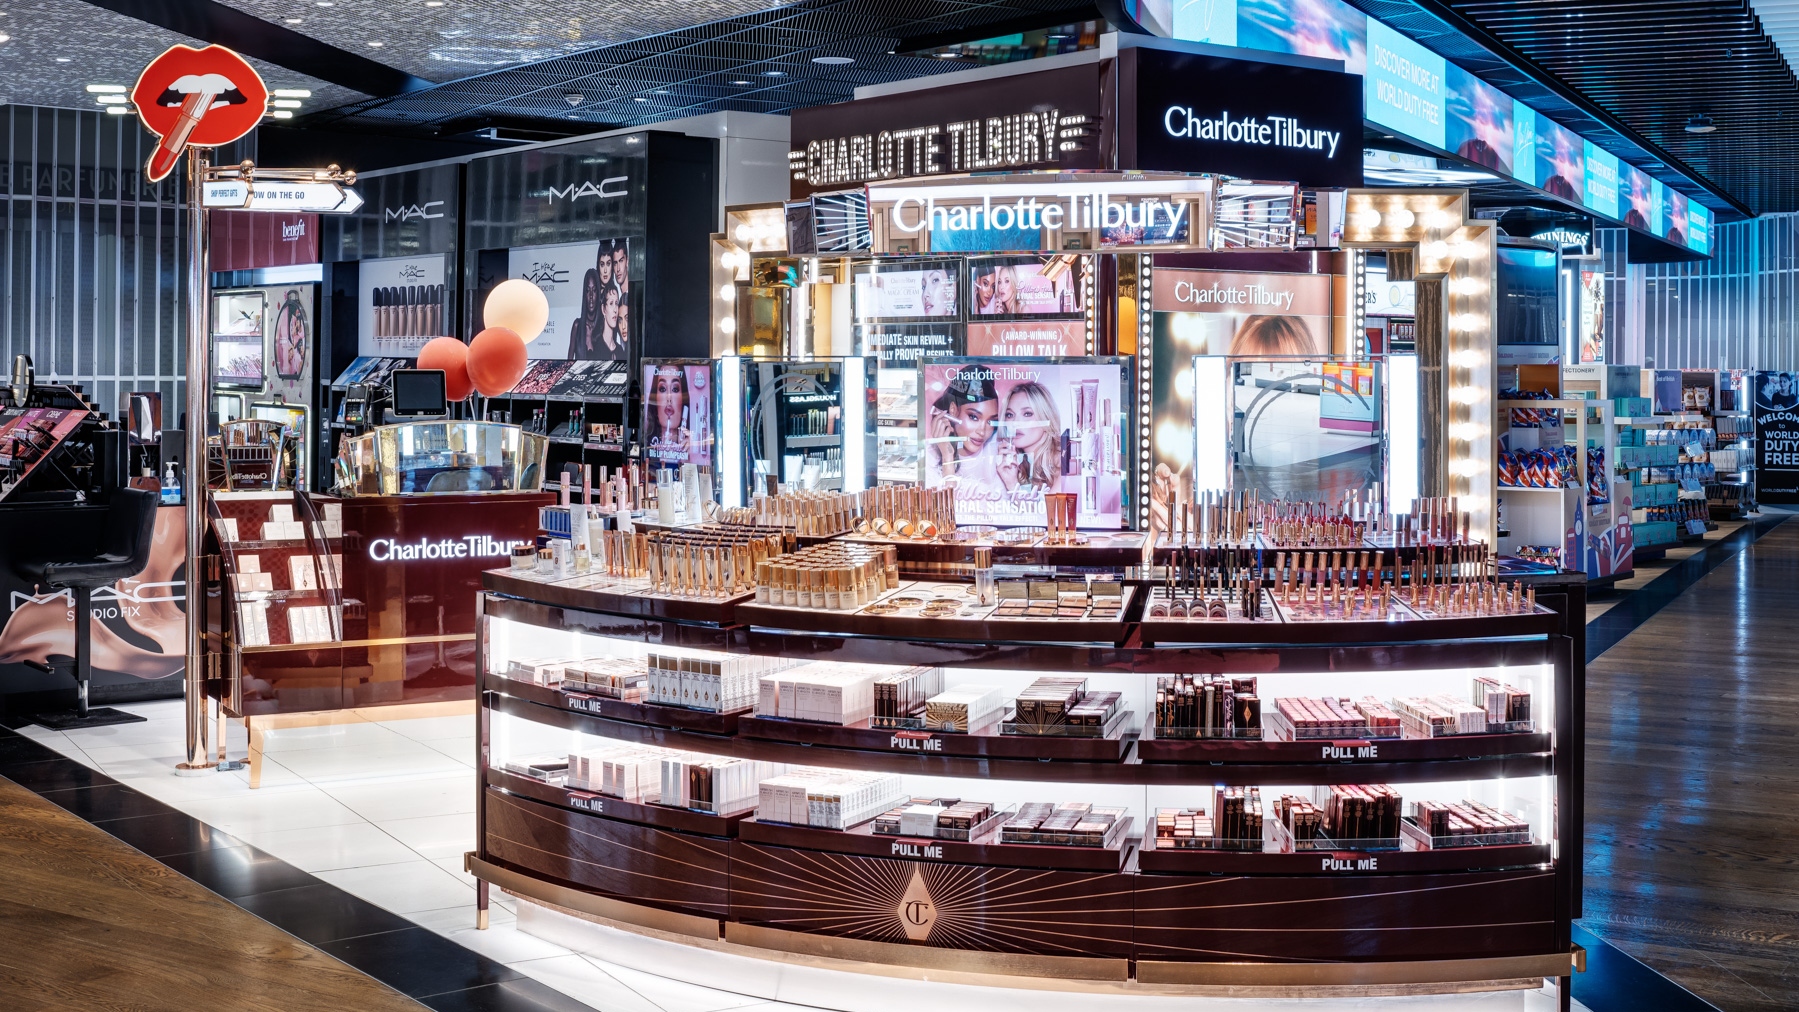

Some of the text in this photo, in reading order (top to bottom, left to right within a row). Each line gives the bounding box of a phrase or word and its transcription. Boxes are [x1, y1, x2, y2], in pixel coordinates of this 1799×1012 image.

[1375, 44, 1439, 95] DISCOVER MORE AT
[1376, 78, 1439, 126] WORLD DUTY FREE
[806, 109, 1060, 186] CHARLOTTE TILBURY
[267, 191, 277, 199] ON
[279, 191, 293, 199] THE
[294, 191, 305, 199] GO
[282, 219, 305, 240] benefit
[903, 334, 918, 346] SKIN
[919, 334, 946, 346] REVIVAL
[1037, 343, 1068, 357] TALK
[1757, 412, 1799, 426] WELCOM
[1765, 431, 1799, 439] WORLD
[1765, 440, 1799, 451] DUTY
[1765, 453, 1799, 465] FREE
[955, 500, 1046, 514] IRAL SENSATIO
[120, 605, 141, 618] FIX
[569, 698, 601, 712] PULL ME
[890, 736, 942, 751] PULL ME
[1322, 745, 1378, 759] PULL ME
[570, 797, 603, 812] PULL ME
[891, 842, 943, 858] PULL ME
[1321, 857, 1378, 871] PULL ME
